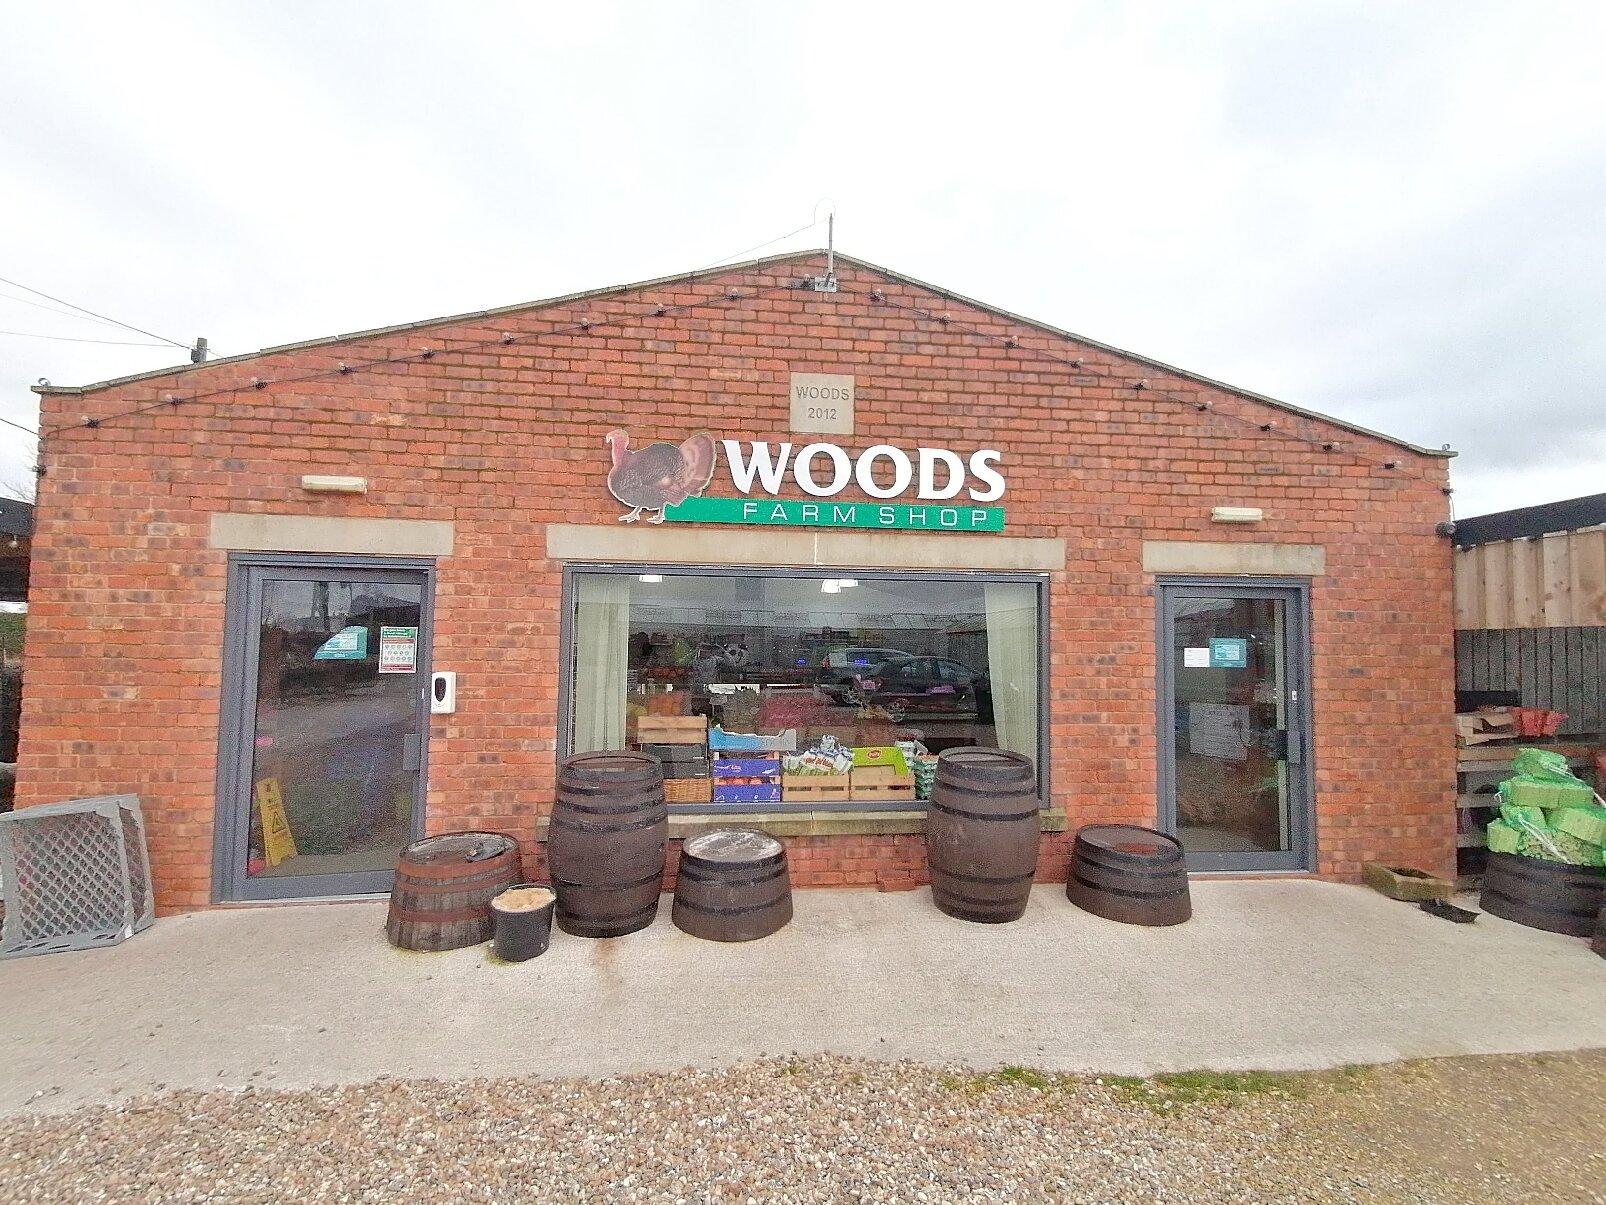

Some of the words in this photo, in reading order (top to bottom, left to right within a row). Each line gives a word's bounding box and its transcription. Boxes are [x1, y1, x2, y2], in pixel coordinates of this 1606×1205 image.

[796, 386, 850, 401] WOODS
[808, 407, 837, 420] 2012
[721, 439, 1006, 502] WOODS
[743, 503, 856, 523] FARM
[879, 506, 988, 527] SHOP
